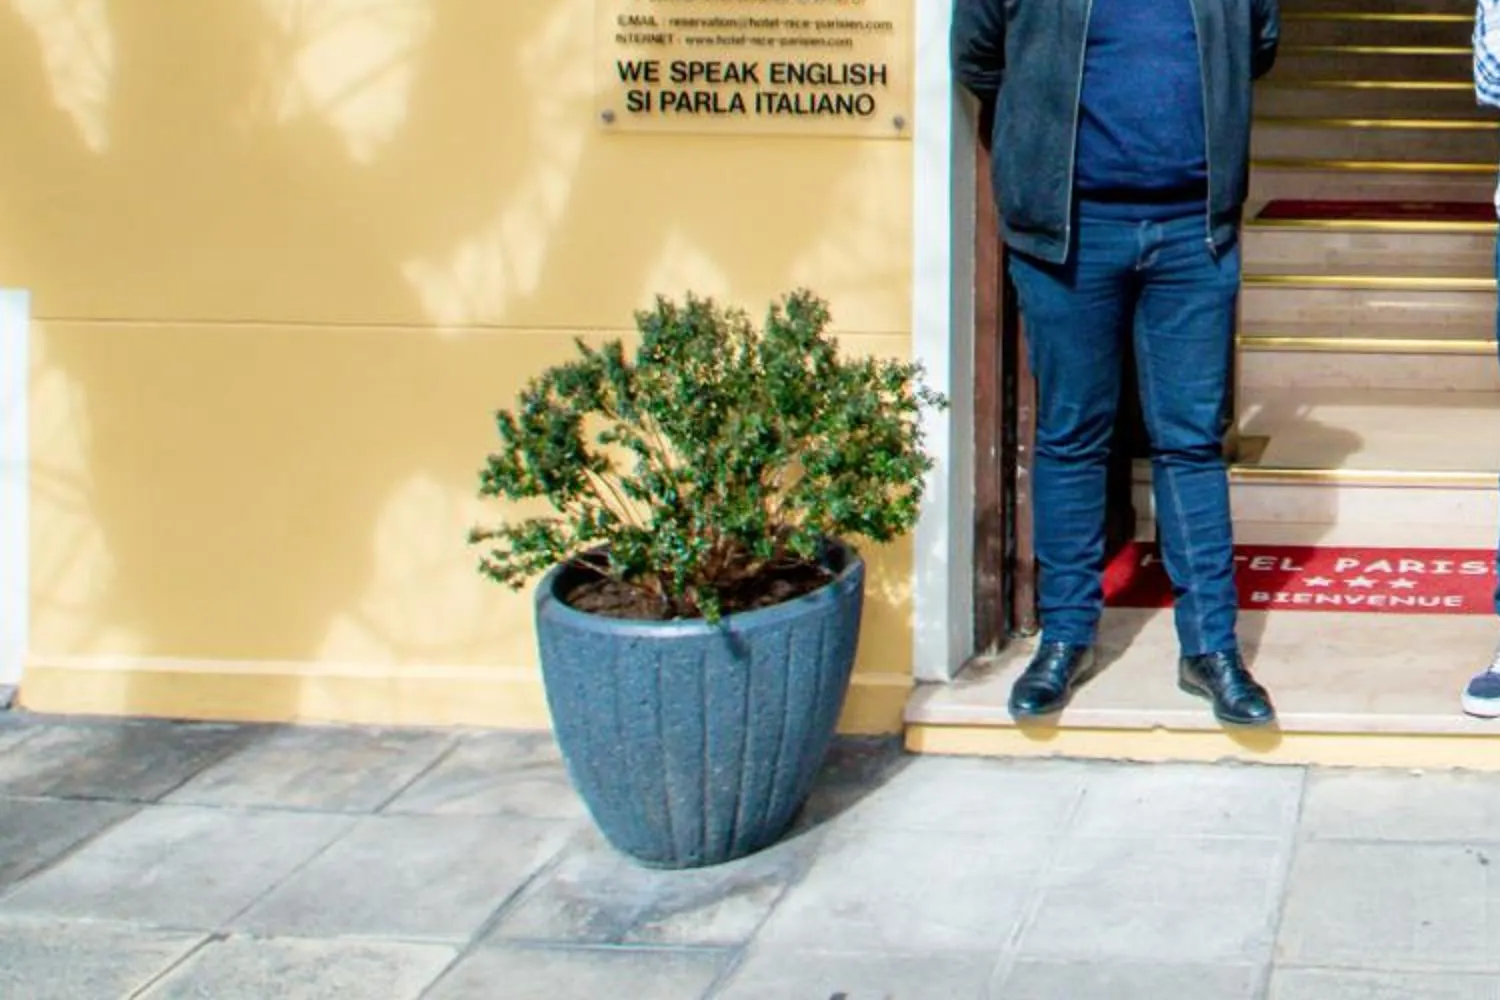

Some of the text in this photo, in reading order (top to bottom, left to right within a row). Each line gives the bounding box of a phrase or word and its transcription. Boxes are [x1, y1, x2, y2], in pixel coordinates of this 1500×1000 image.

[616, 60, 887, 86] WE SPEAK ENGLISH
[626, 89, 876, 117] SI PARLA ITALIANO
[1251, 590, 1464, 608] BIENVENUE
